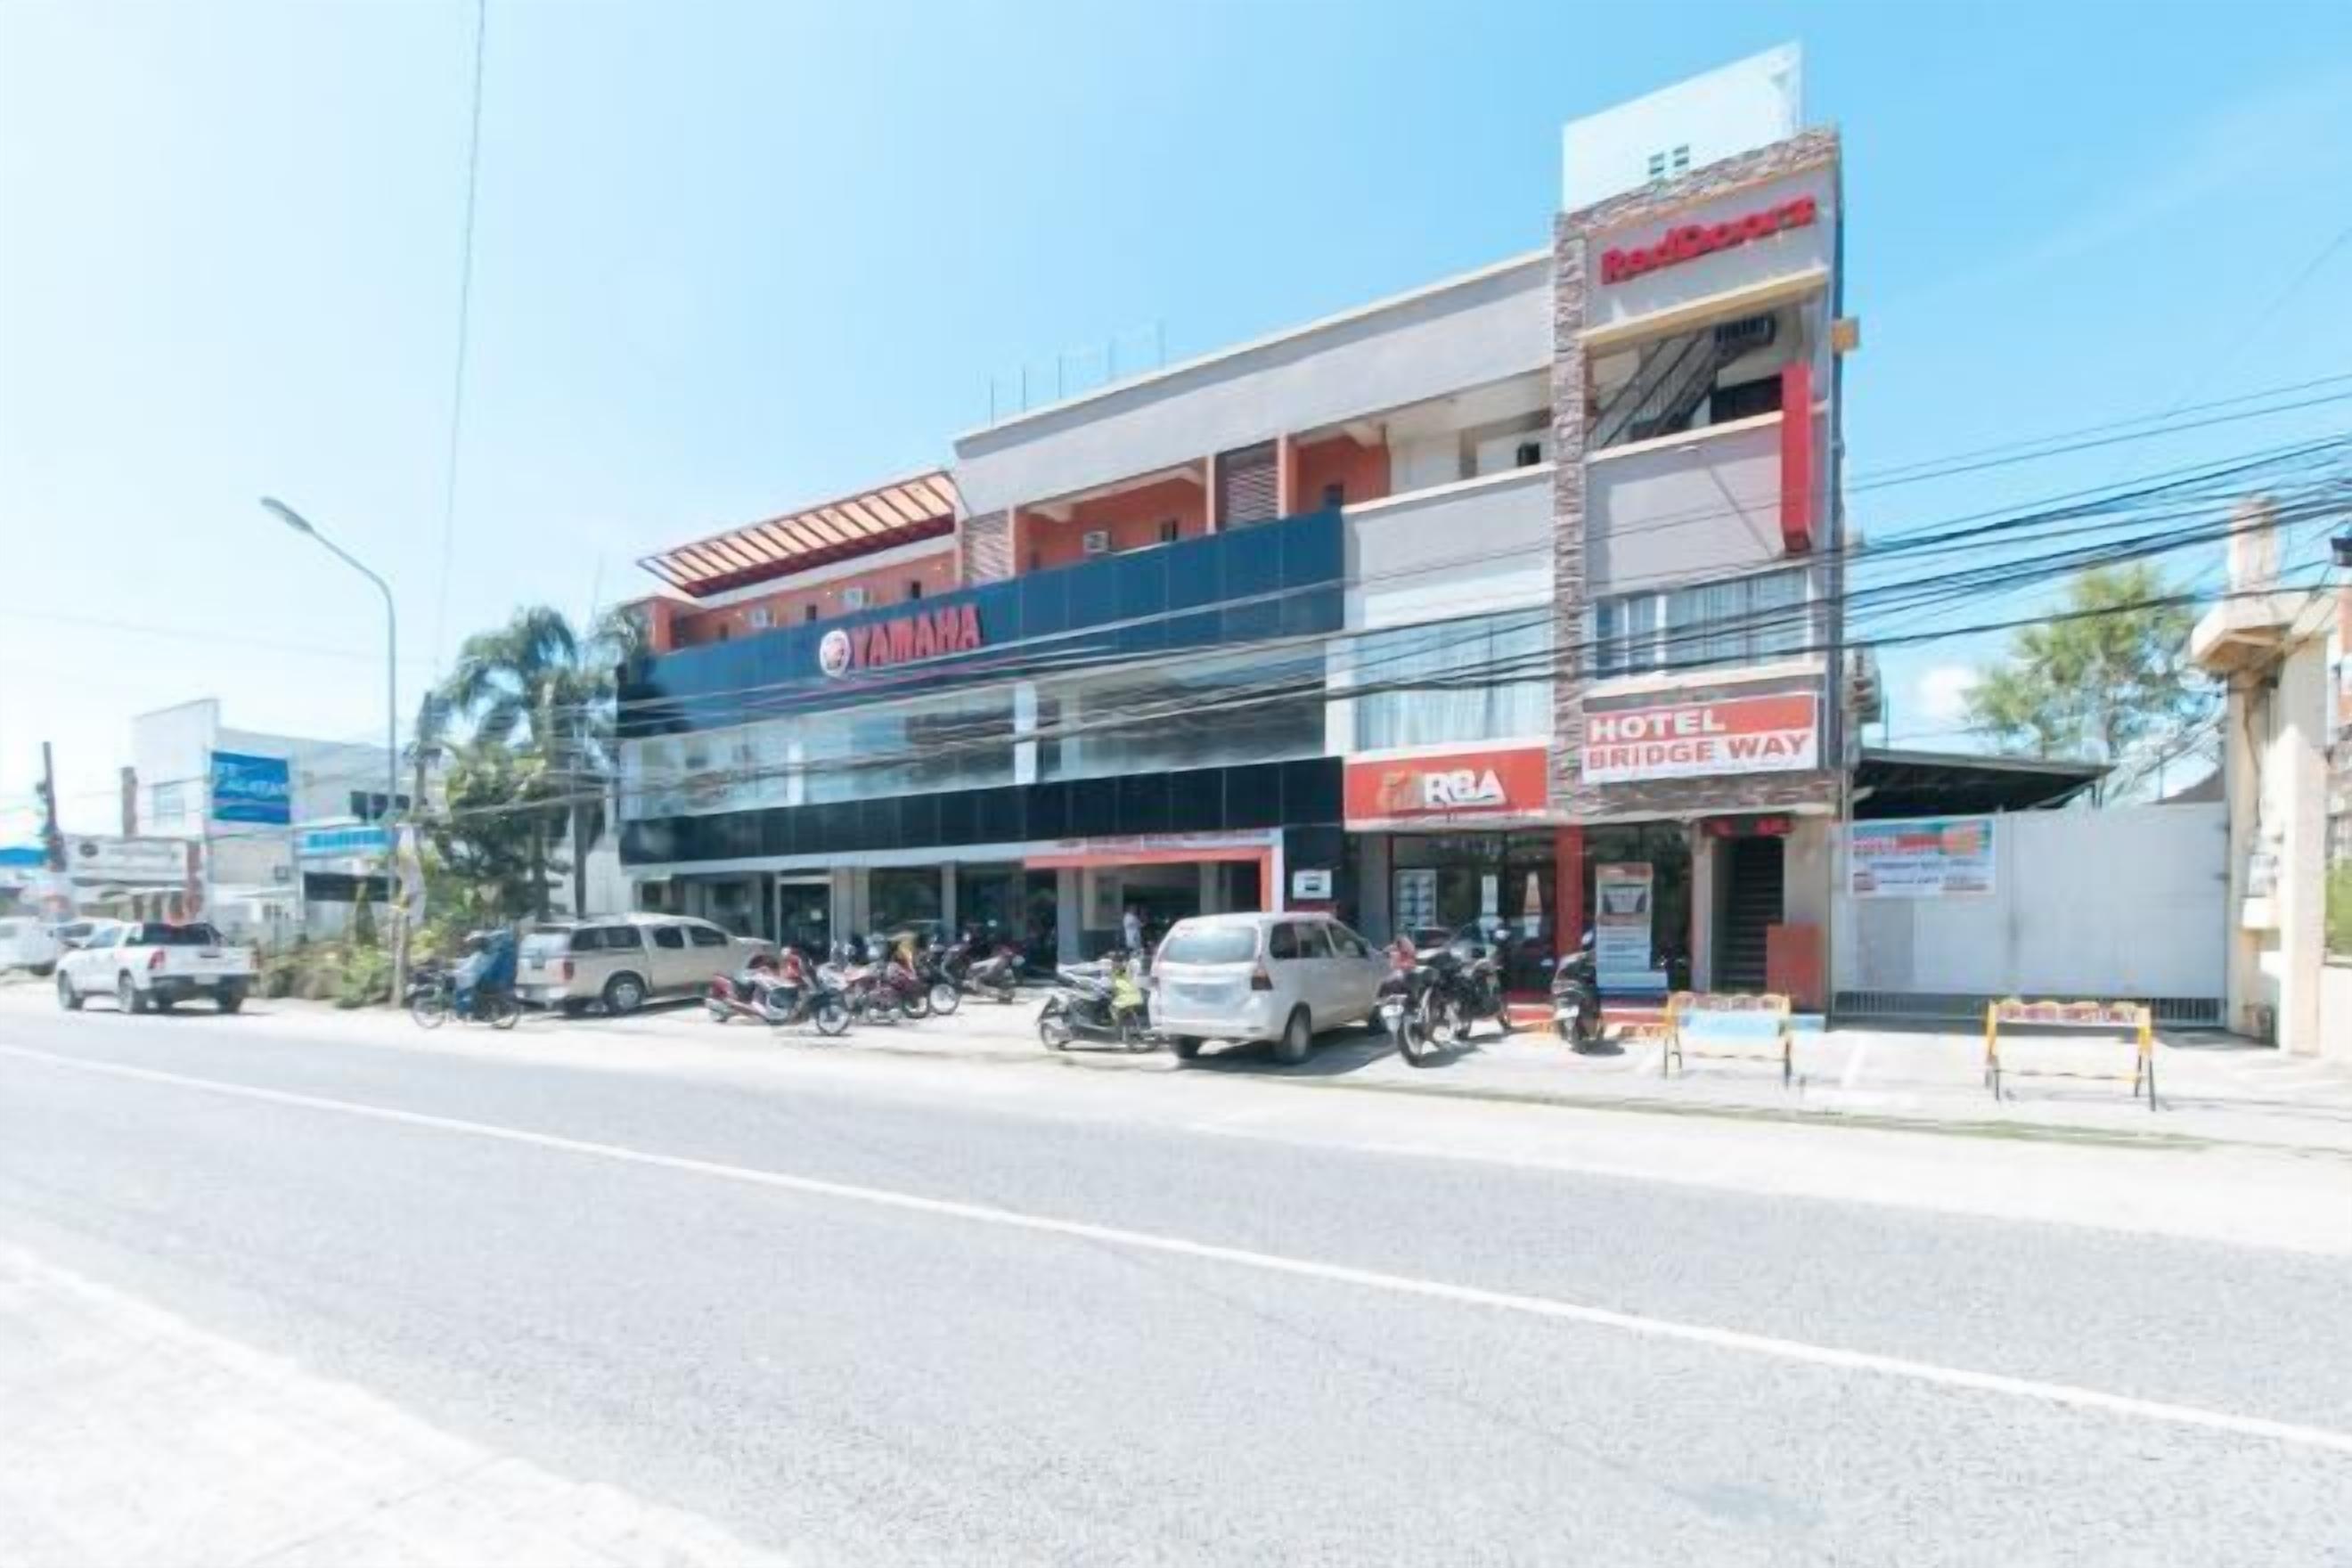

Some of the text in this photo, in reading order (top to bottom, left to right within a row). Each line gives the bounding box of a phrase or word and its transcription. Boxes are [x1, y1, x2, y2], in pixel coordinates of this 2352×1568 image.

[852, 603, 982, 669] YAMAHA
[1589, 709, 1727, 742] HOTEL
[1588, 733, 1807, 770] BRIDGE WAY
